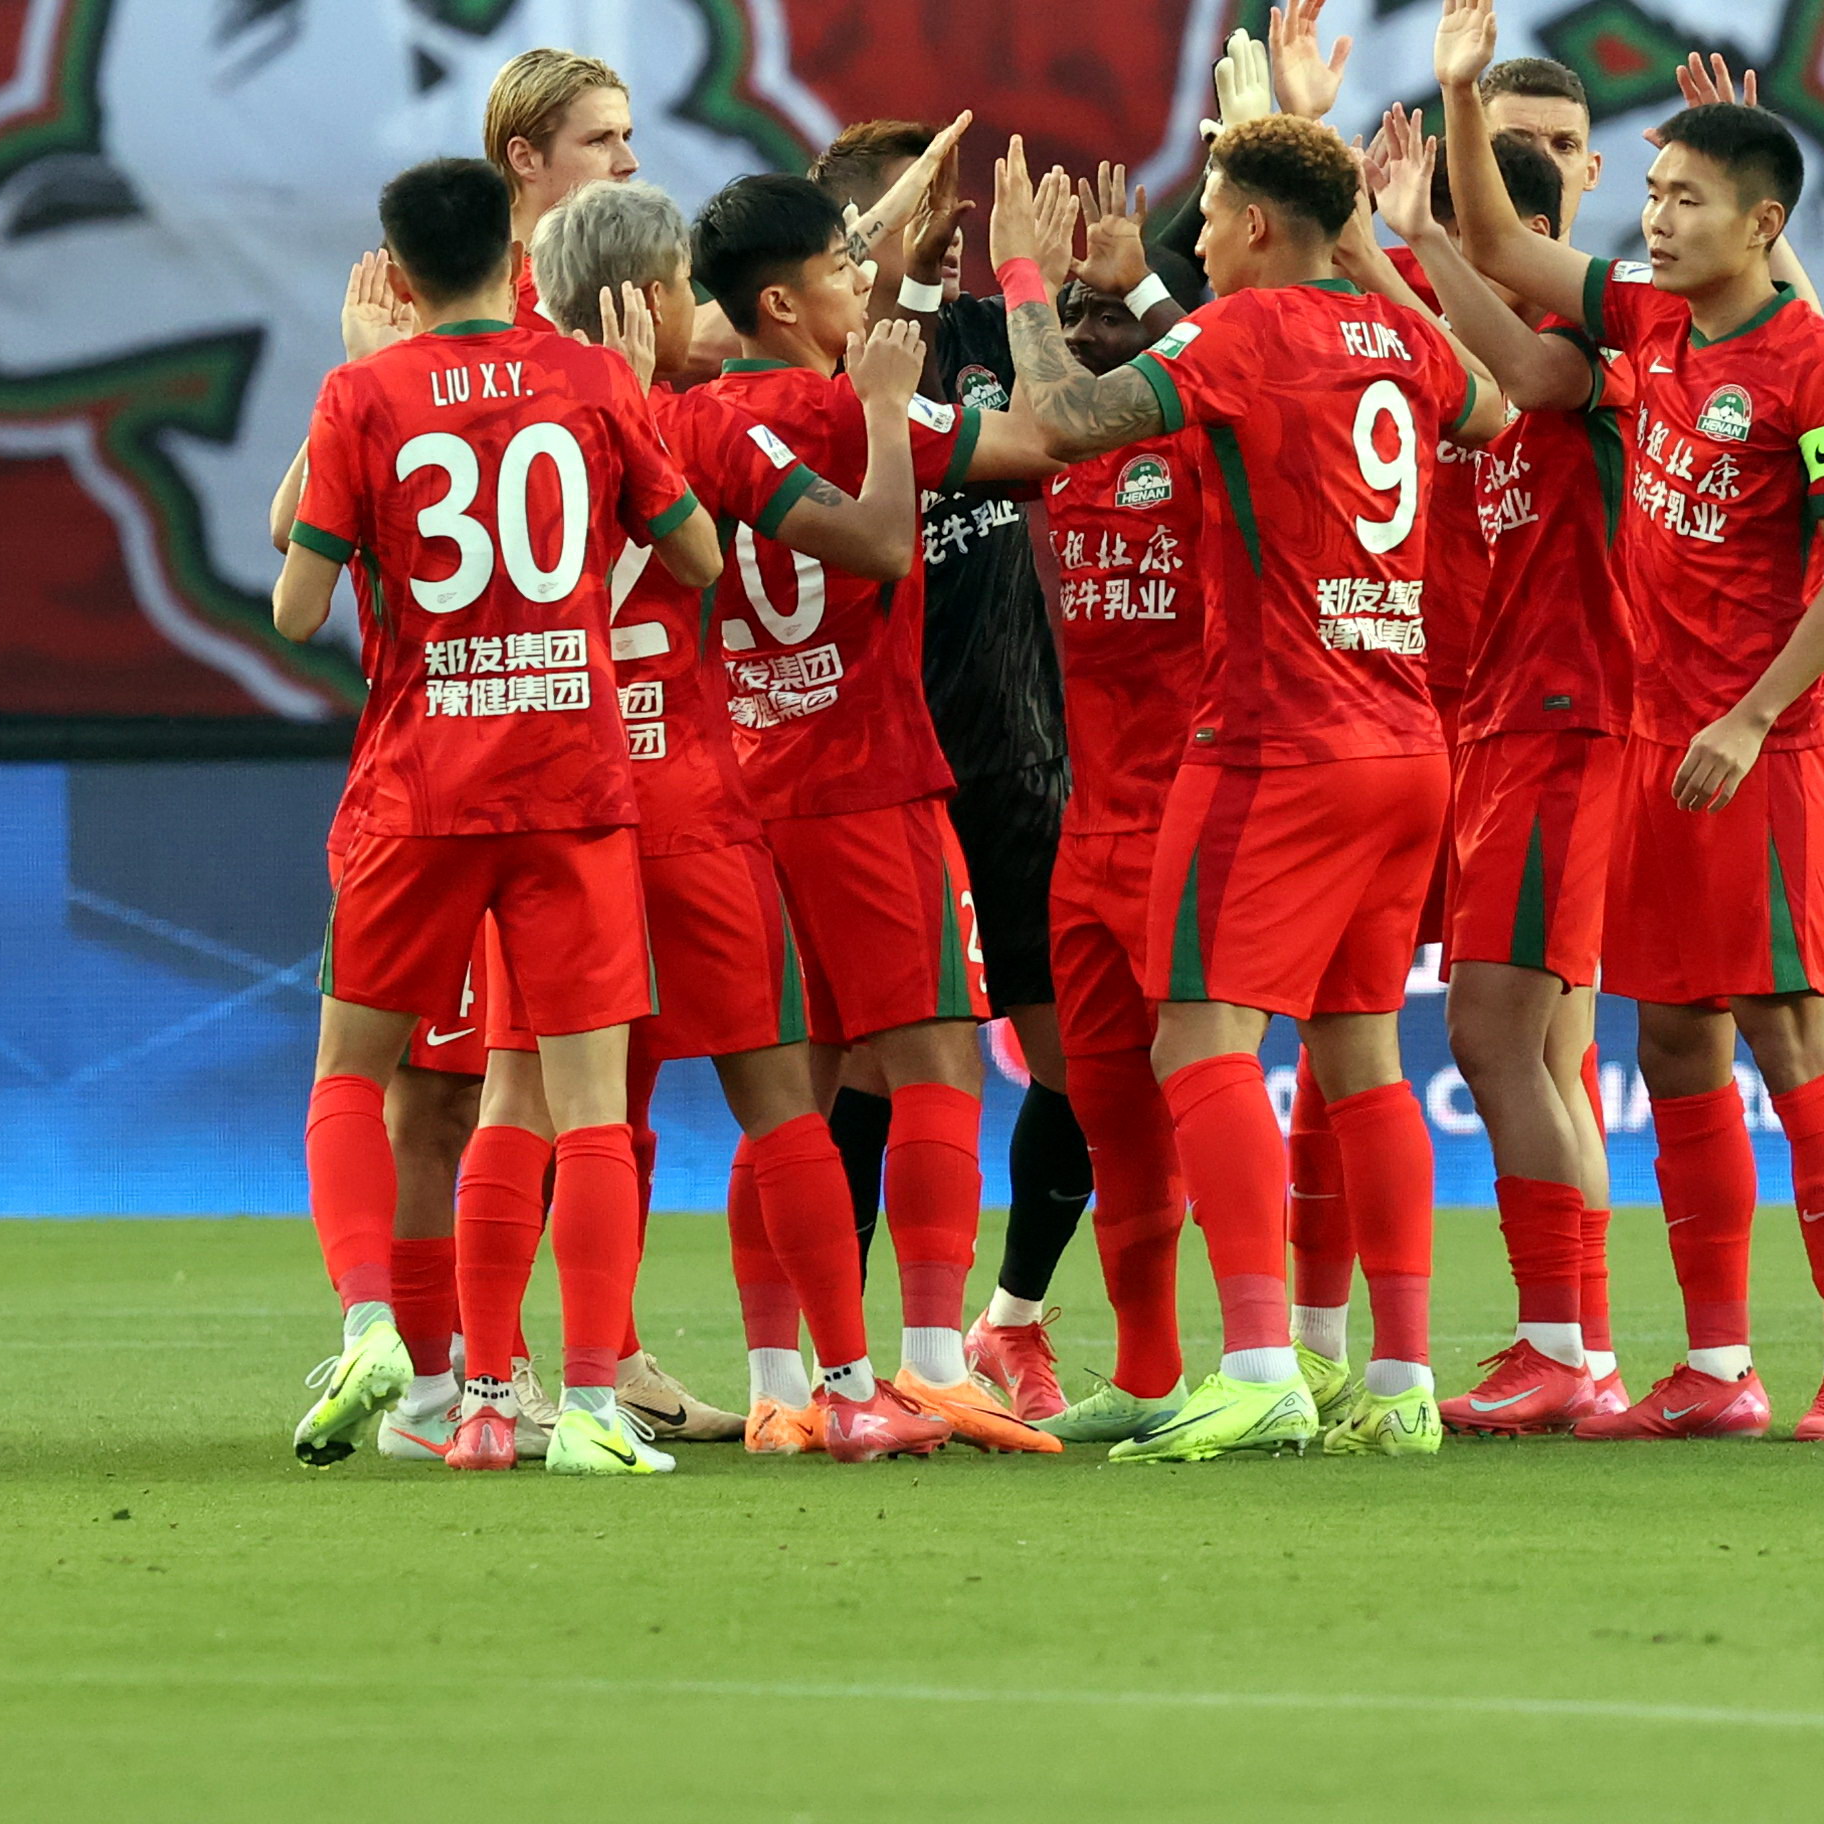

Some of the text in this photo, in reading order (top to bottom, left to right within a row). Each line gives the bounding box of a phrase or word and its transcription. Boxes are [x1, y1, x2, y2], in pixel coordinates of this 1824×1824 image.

[430, 361, 534, 406] LIU X.Y.
[1701, 418, 1743, 437] HENAN
[1351, 379, 1418, 555] 9
[396, 422, 590, 614] 30
[1122, 487, 1166, 504] HENAN
[425, 629, 588, 676] 郑发集团
[425, 671, 590, 717] 豫健集团
